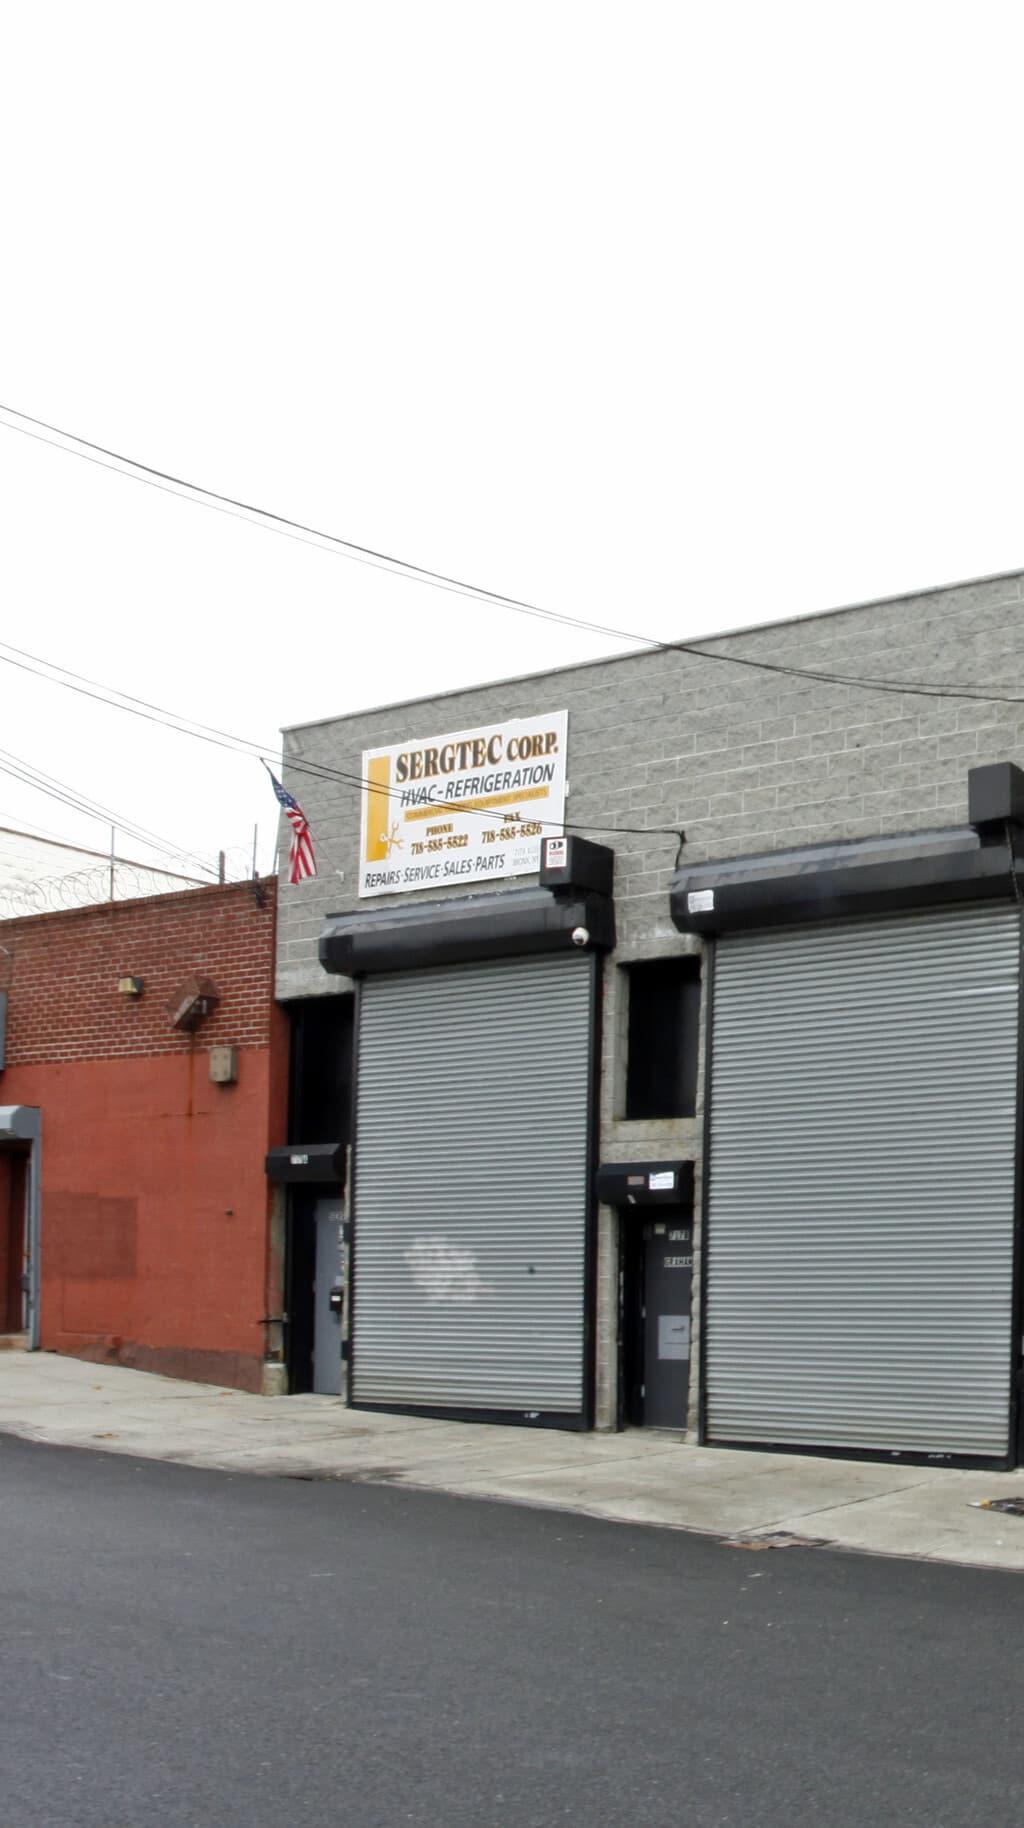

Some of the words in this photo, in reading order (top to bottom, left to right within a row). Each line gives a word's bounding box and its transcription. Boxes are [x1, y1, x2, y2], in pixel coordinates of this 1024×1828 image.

[396, 734, 503, 783] SERGTEC
[506, 731, 559, 762] CORP.
[426, 823, 454, 837] PHONE
